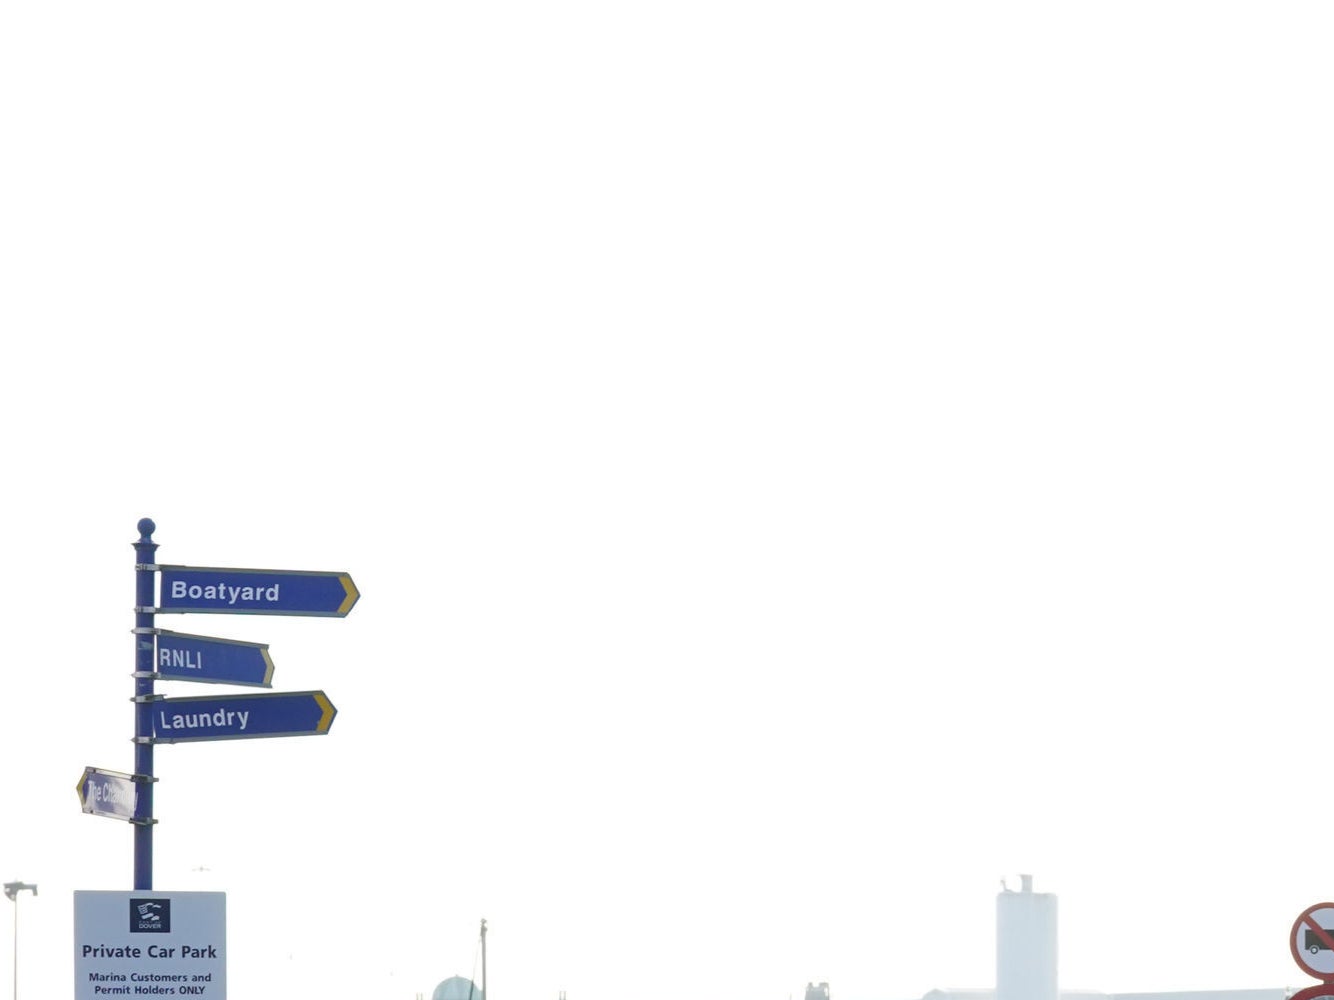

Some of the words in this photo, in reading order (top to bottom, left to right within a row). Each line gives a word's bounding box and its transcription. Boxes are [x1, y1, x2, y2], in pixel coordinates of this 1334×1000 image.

[171, 581, 279, 604] Boatyard
[160, 649, 202, 669] RNLI
[161, 709, 249, 729] Laundry
[82, 944, 141, 958] Private
[147, 945, 175, 958] Car
[181, 945, 217, 958] Park
[89, 972, 126, 982] Marina
[130, 973, 188, 982] Customers
[191, 973, 212, 982] and
[95, 985, 131, 995] Permit
[134, 986, 175, 995] Holders
[179, 986, 206, 995] ONLY
